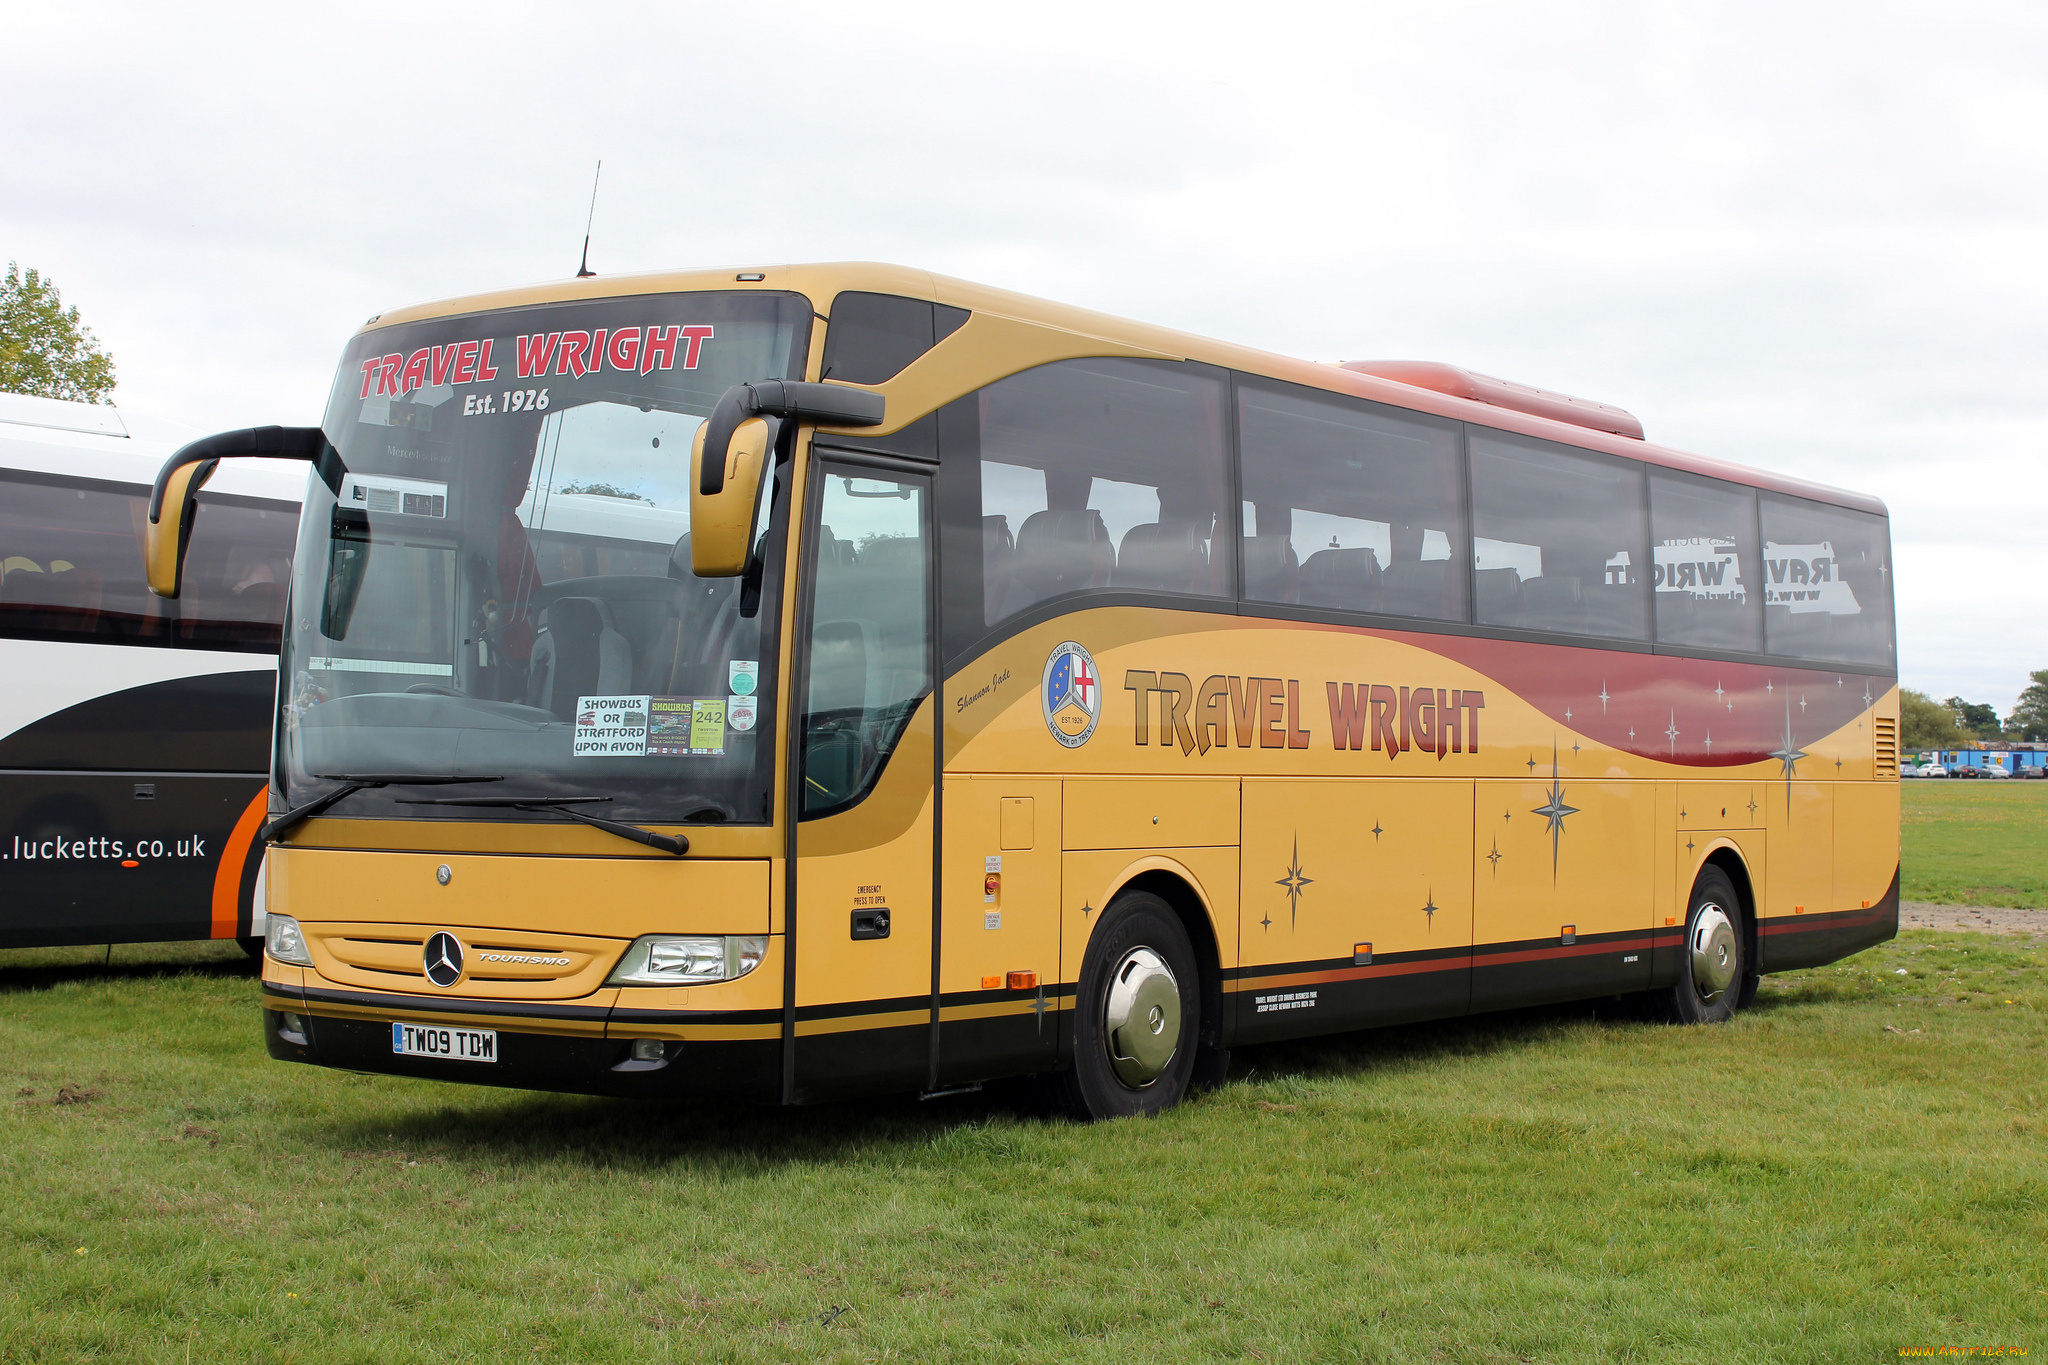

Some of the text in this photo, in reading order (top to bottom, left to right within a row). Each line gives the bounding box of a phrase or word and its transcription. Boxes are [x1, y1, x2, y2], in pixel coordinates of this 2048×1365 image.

[360, 325, 714, 400] TRAVEL WRIGHT
[463, 388, 550, 416] Est. 1926
[1050, 643, 1094, 666] TRAVEL WRIGHT
[956, 668, 1011, 713] Shannon Jade
[584, 699, 642, 710] SHOWBUS
[652, 703, 692, 712] SHOWBUS
[603, 713, 620, 724] OR
[695, 711, 723, 724] 242
[1061, 716, 1084, 725] EST. 1926
[1124, 669, 1485, 762] TRAVEL WRIGHT
[577, 727, 645, 738] STRATFORD
[1050, 721, 1070, 745] NEWARK
[1078, 724, 1095, 744] TRENT
[575, 742, 644, 752] UPON AVON
[857, 885, 882, 894] EMERGENCY
[854, 895, 886, 905] PRESS TO OPEN
[478, 953, 571, 968] TOURISMO
[404, 1027, 493, 1058] TW09 TDW
